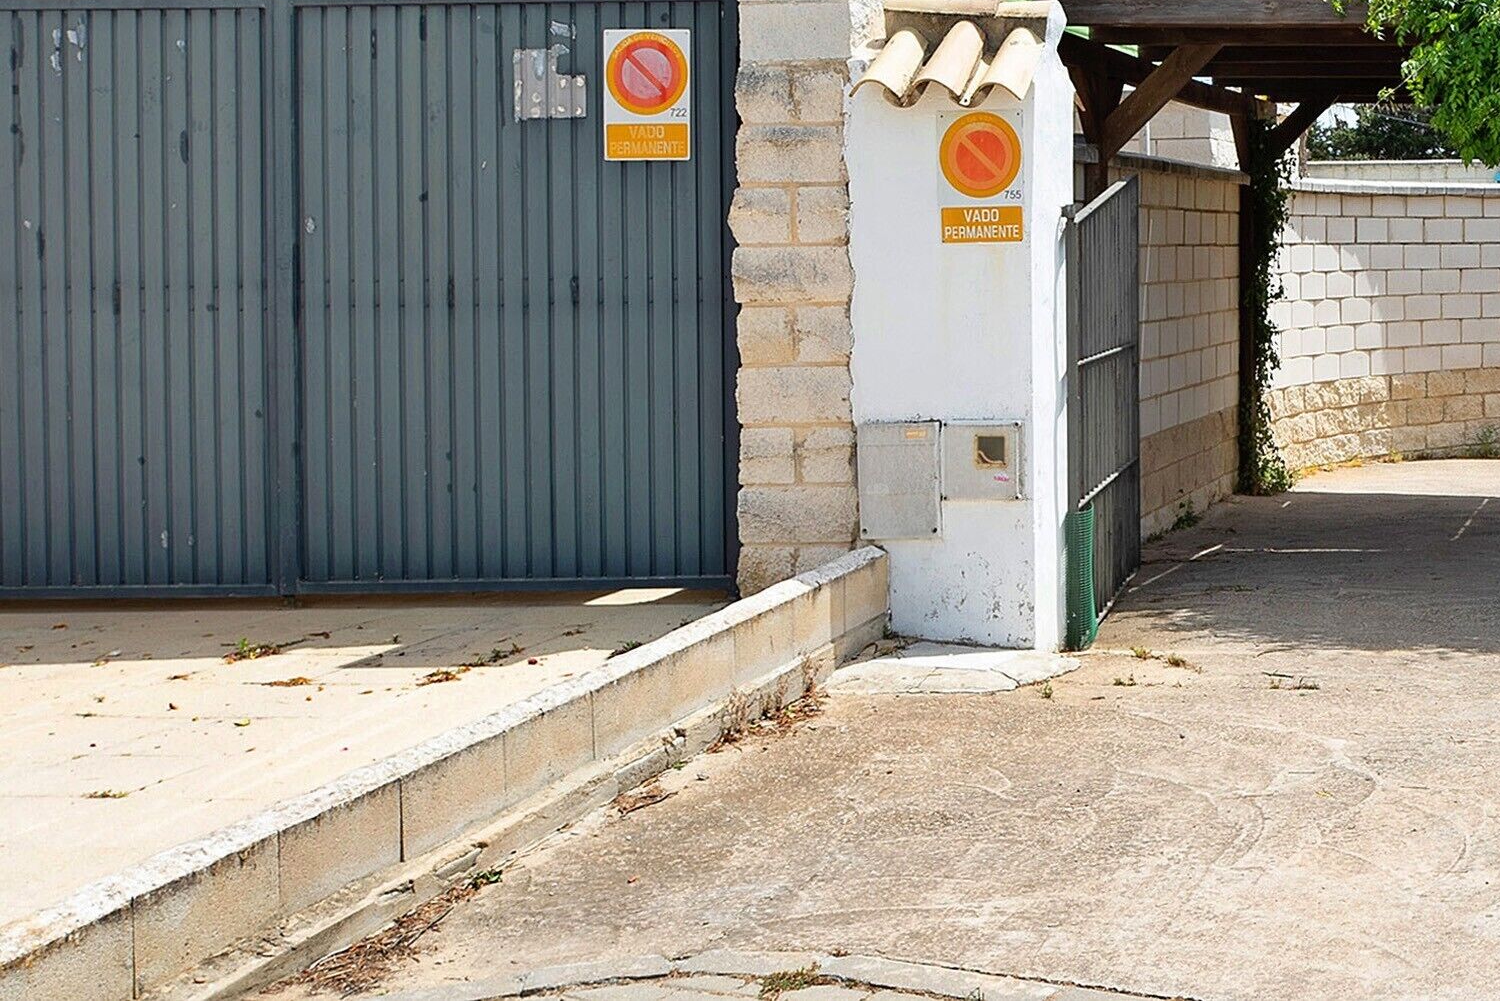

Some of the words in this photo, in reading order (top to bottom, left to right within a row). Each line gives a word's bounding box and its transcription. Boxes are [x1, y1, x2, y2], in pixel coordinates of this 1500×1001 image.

[670, 108, 687, 117] 722
[628, 125, 665, 138] VADO
[609, 141, 686, 154] PERMANENTE
[1004, 190, 1022, 199] 755
[963, 209, 999, 222] VADO
[944, 225, 1020, 239] PERMANENTE
